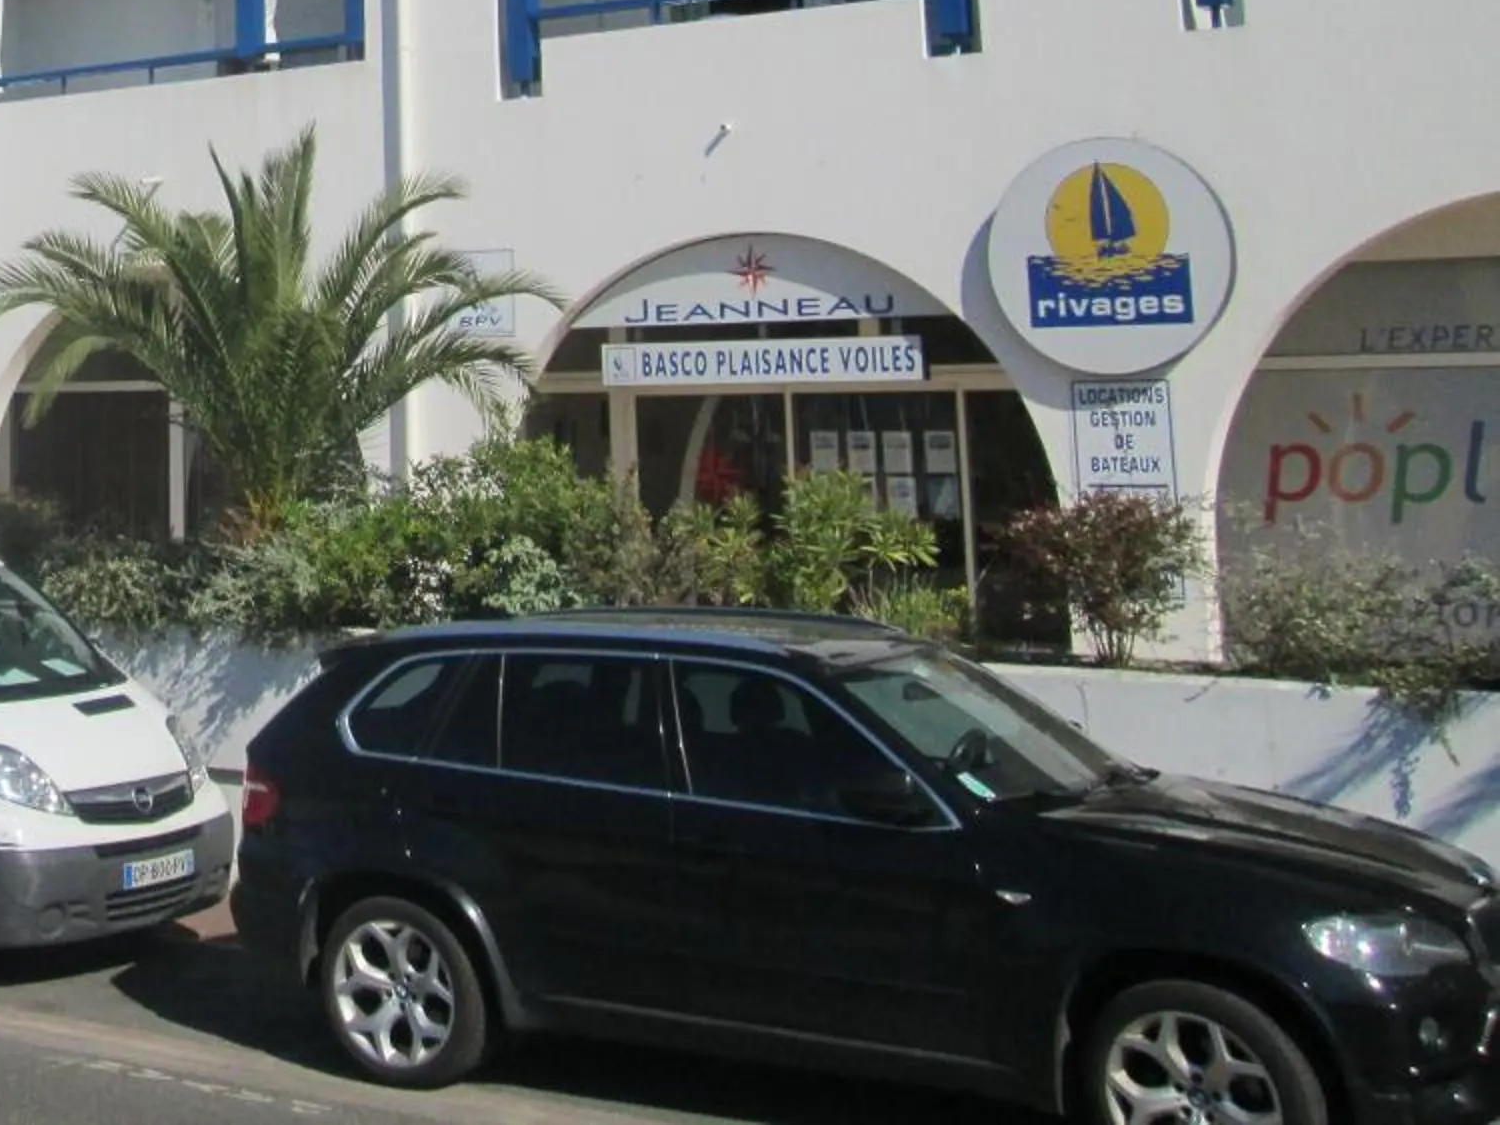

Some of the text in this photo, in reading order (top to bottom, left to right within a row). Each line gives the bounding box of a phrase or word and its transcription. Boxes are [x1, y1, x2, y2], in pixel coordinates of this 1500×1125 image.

[625, 293, 894, 323] JEANNEAU
[1037, 292, 1186, 321] rivages
[642, 344, 916, 378] BASCO PLAISANCE VOILES
[1078, 386, 1165, 405] LOCATIONS
[1089, 410, 1156, 427] GESTION
[1114, 434, 1135, 450] DE
[1091, 457, 1161, 474] BATEAUX
